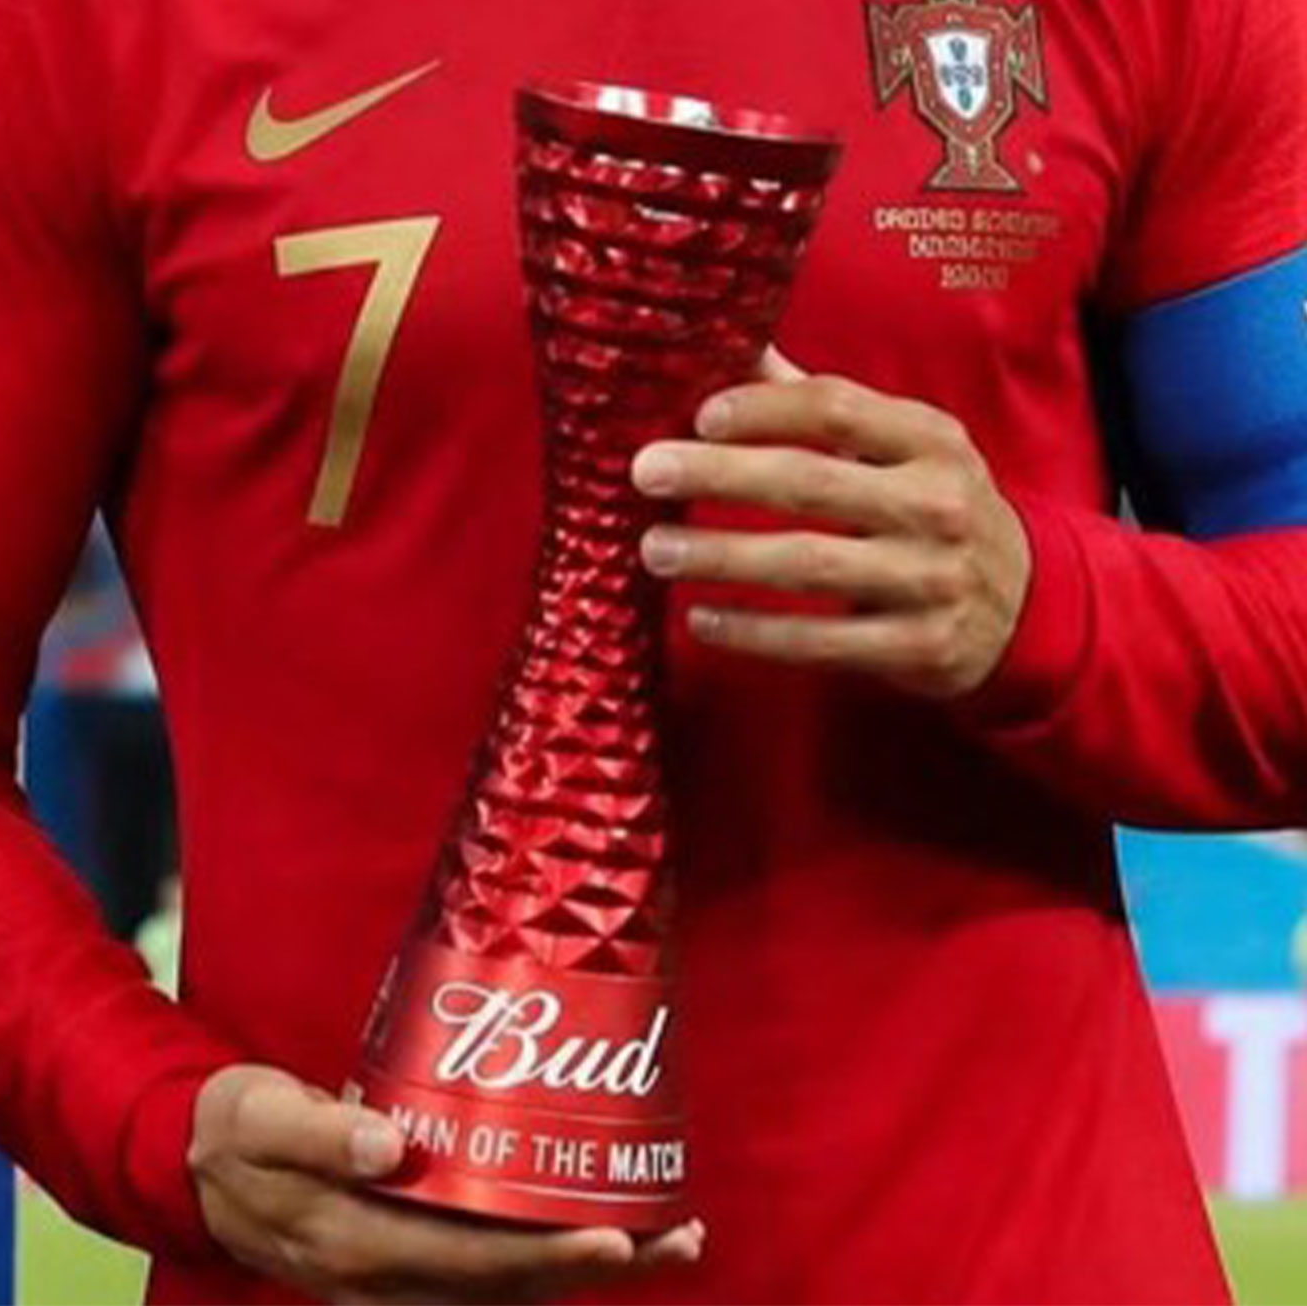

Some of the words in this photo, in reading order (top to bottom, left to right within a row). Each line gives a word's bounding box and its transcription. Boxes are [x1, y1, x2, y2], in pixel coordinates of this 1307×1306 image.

[274, 214, 442, 527] 7
[432, 981, 669, 1097] Bud
[467, 1123, 521, 1168] OF
[532, 1133, 598, 1180] THE
